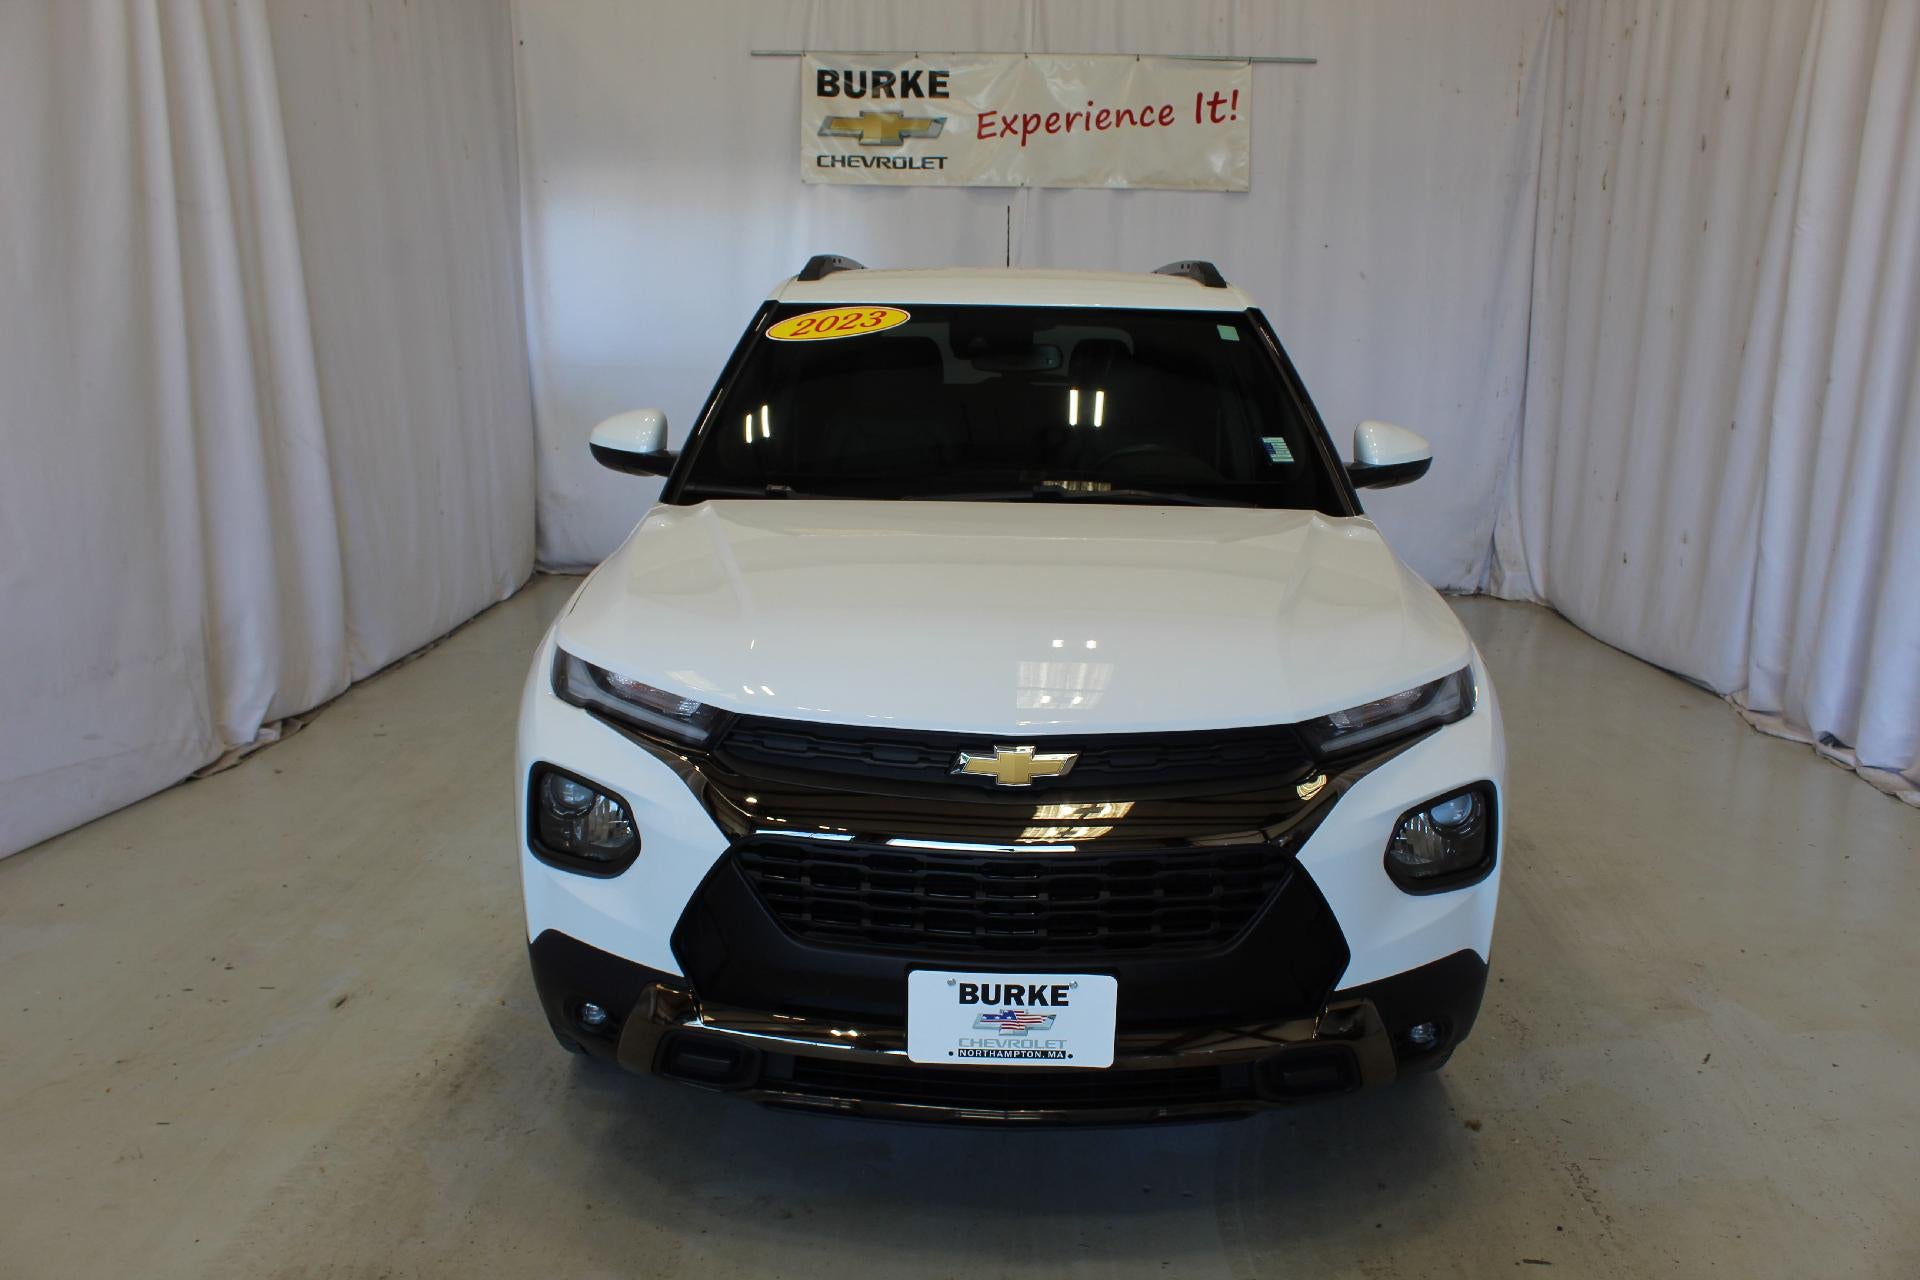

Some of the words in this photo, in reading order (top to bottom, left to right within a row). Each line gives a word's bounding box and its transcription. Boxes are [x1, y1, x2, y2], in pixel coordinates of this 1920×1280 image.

[817, 69, 950, 100] BURKE
[976, 100, 1174, 146] Experience
[1195, 89, 1239, 124] It!
[816, 154, 948, 170] CHEVROLET
[790, 311, 887, 336] 2023
[959, 983, 1070, 1007] BURKE
[958, 1038, 1067, 1049] CHEVROLET
[1047, 1050, 1064, 1059] MA
